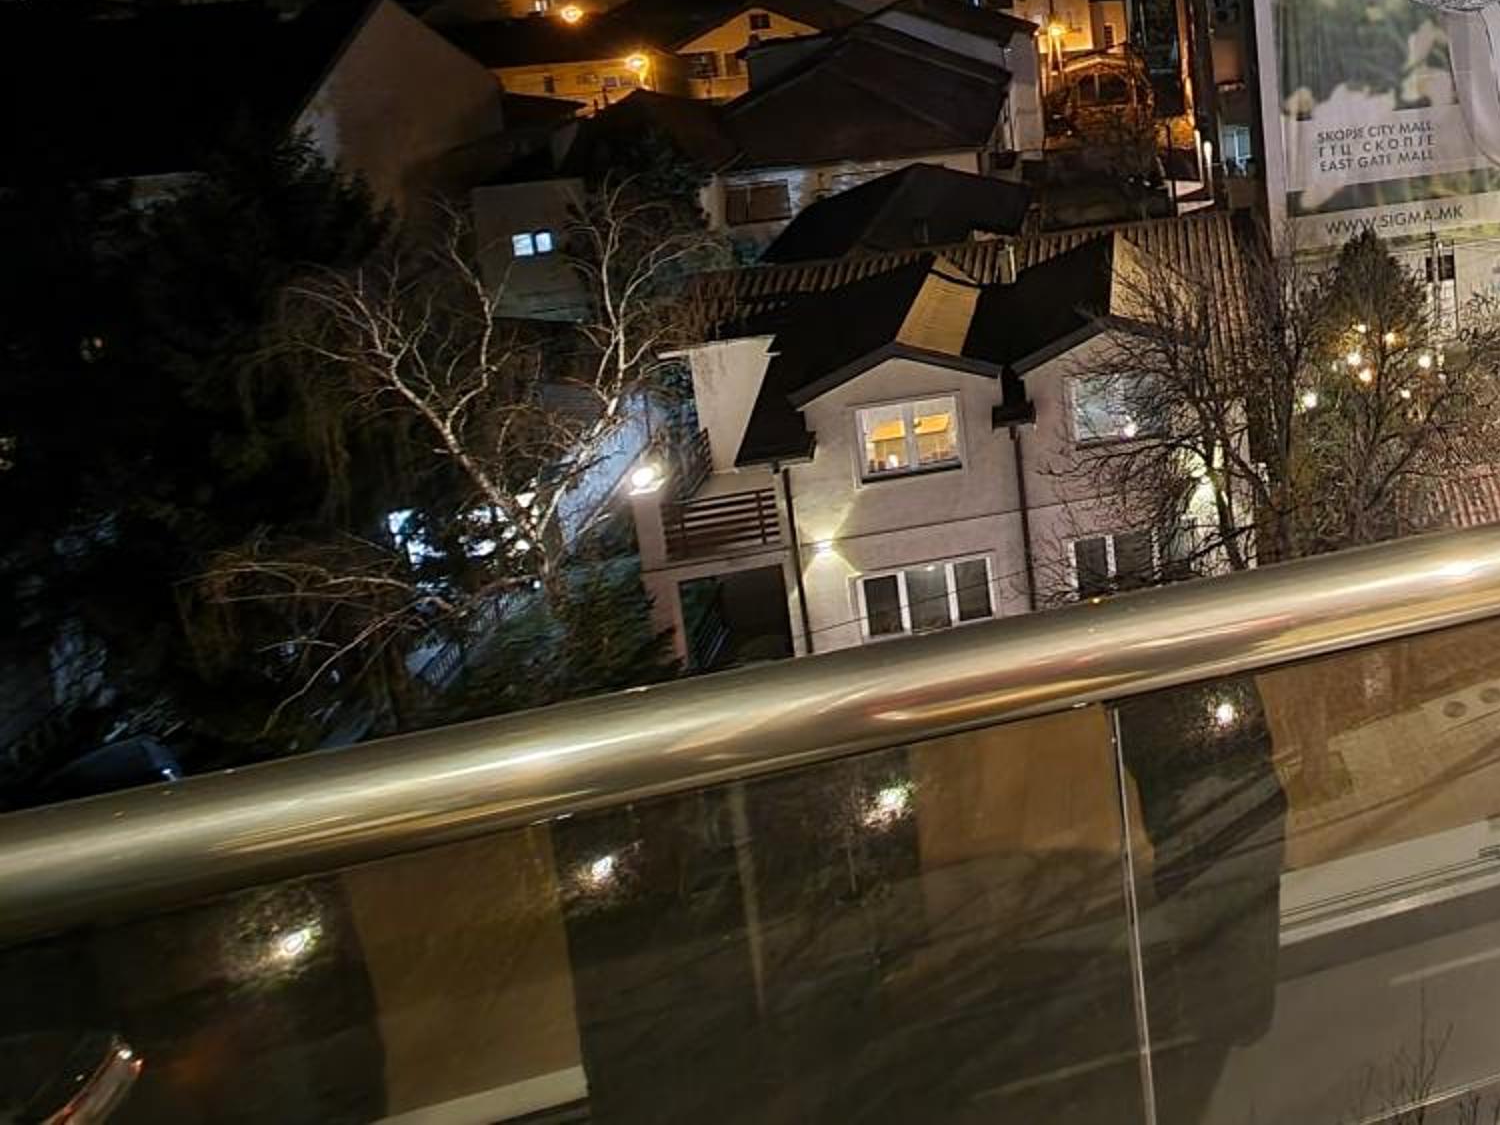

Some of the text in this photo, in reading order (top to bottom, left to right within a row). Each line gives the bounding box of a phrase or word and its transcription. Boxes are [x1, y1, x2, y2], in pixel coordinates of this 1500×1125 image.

[1317, 121, 1434, 144] SKOPJE CITY MALL
[1320, 151, 1434, 172] EAST GATE MALL
